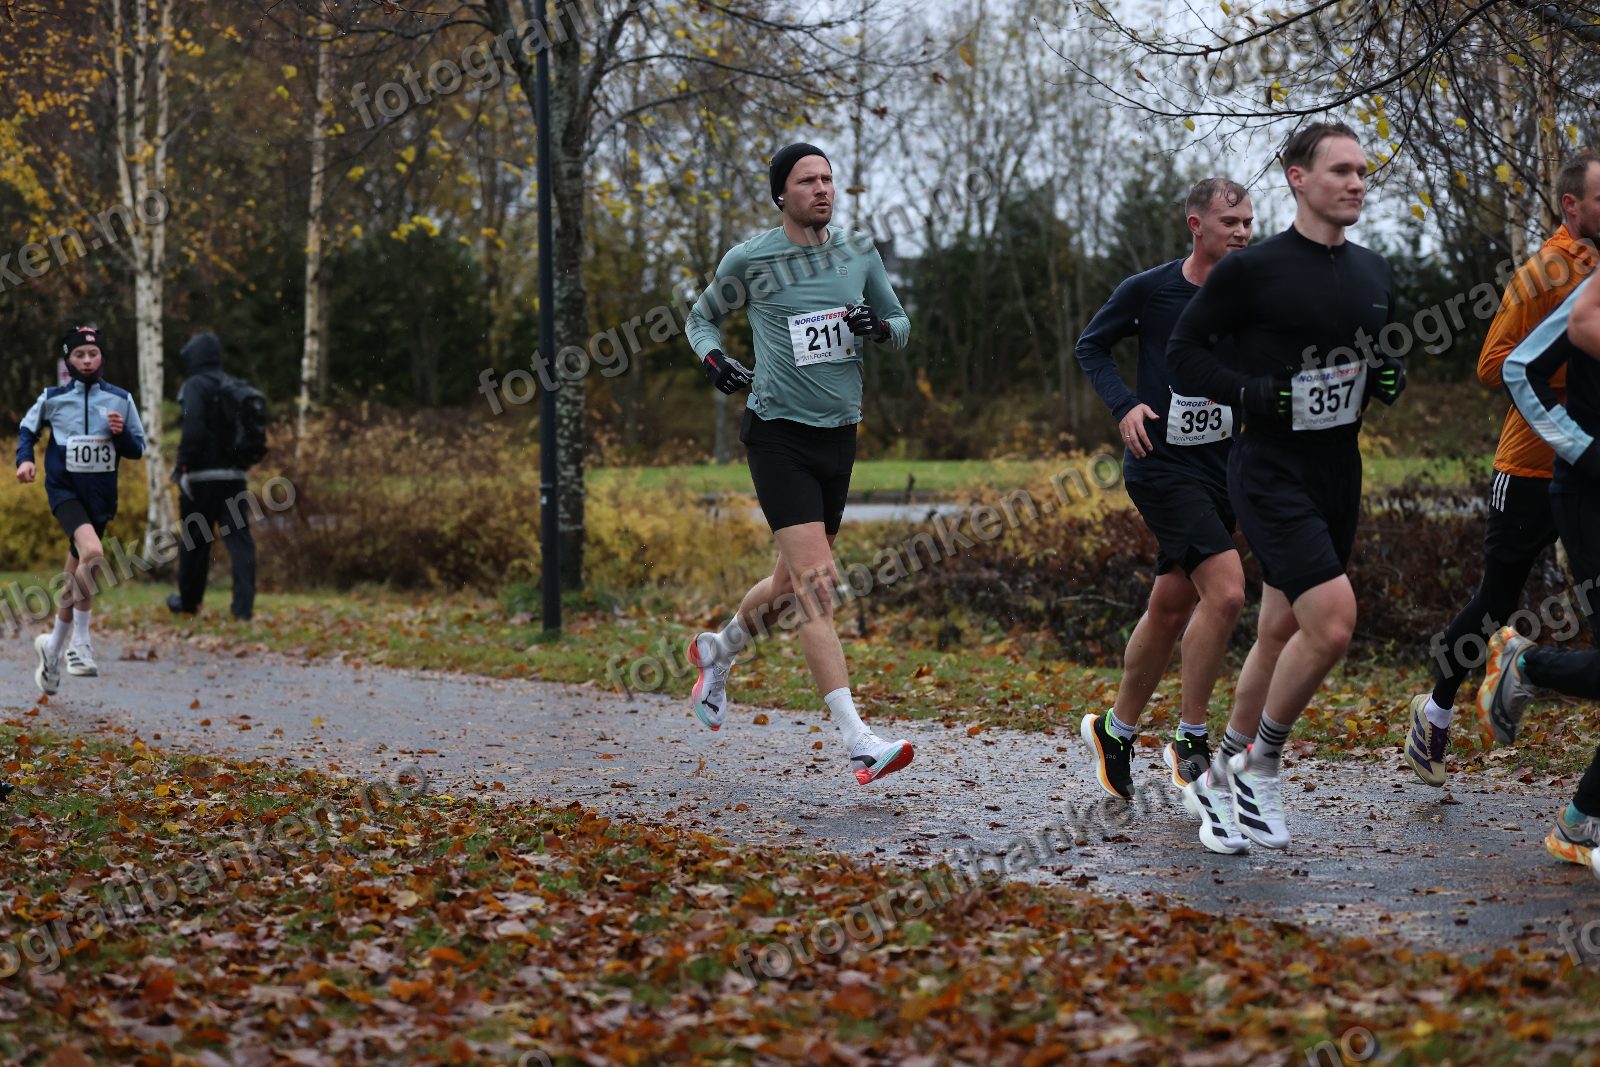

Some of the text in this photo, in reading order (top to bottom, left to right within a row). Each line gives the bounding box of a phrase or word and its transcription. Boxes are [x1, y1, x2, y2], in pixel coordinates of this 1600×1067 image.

[805, 322, 842, 351] 211
[1308, 380, 1355, 415] 357
[1180, 407, 1222, 434] 393
[72, 445, 111, 463] 1013
